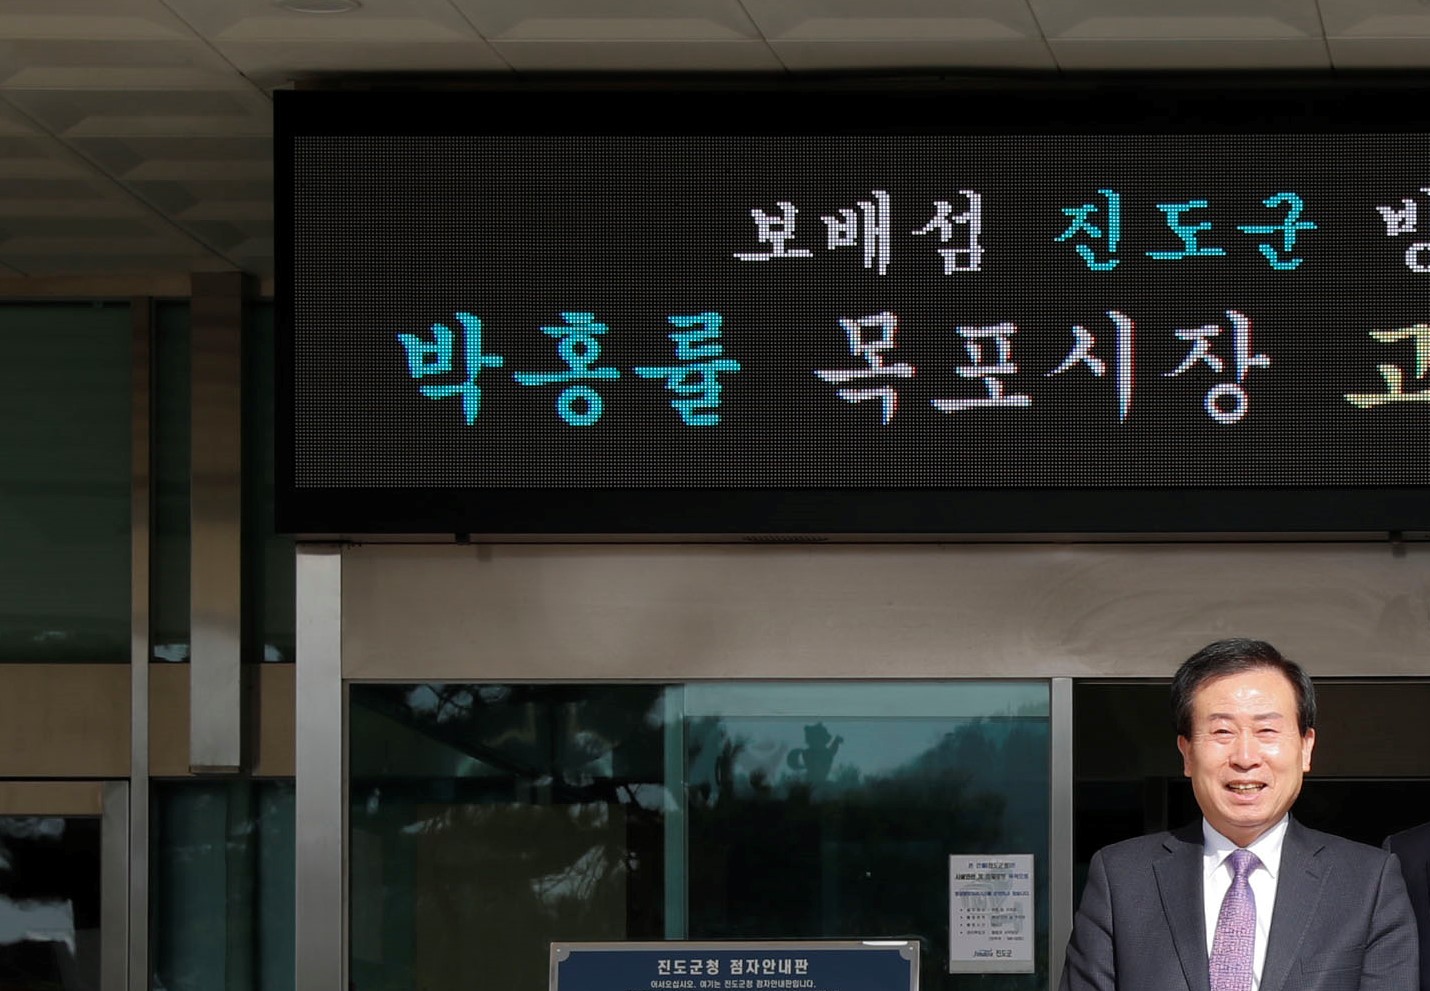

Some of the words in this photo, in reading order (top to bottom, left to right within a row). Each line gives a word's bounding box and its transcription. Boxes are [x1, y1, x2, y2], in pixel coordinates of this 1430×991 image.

[734, 190, 985, 276] 보배섬
[1054, 189, 1318, 271] 진도군
[397, 311, 741, 426] 박홍률
[813, 310, 1271, 426] 목포시장
[650, 980, 696, 989] 어서오십시오.
[699, 979, 721, 989] 여기는
[724, 979, 753, 989] 진도군청
[756, 979, 816, 989] 점자안내판입니다.
[657, 959, 719, 975] 진도군청
[729, 958, 809, 975] 점자안내판
